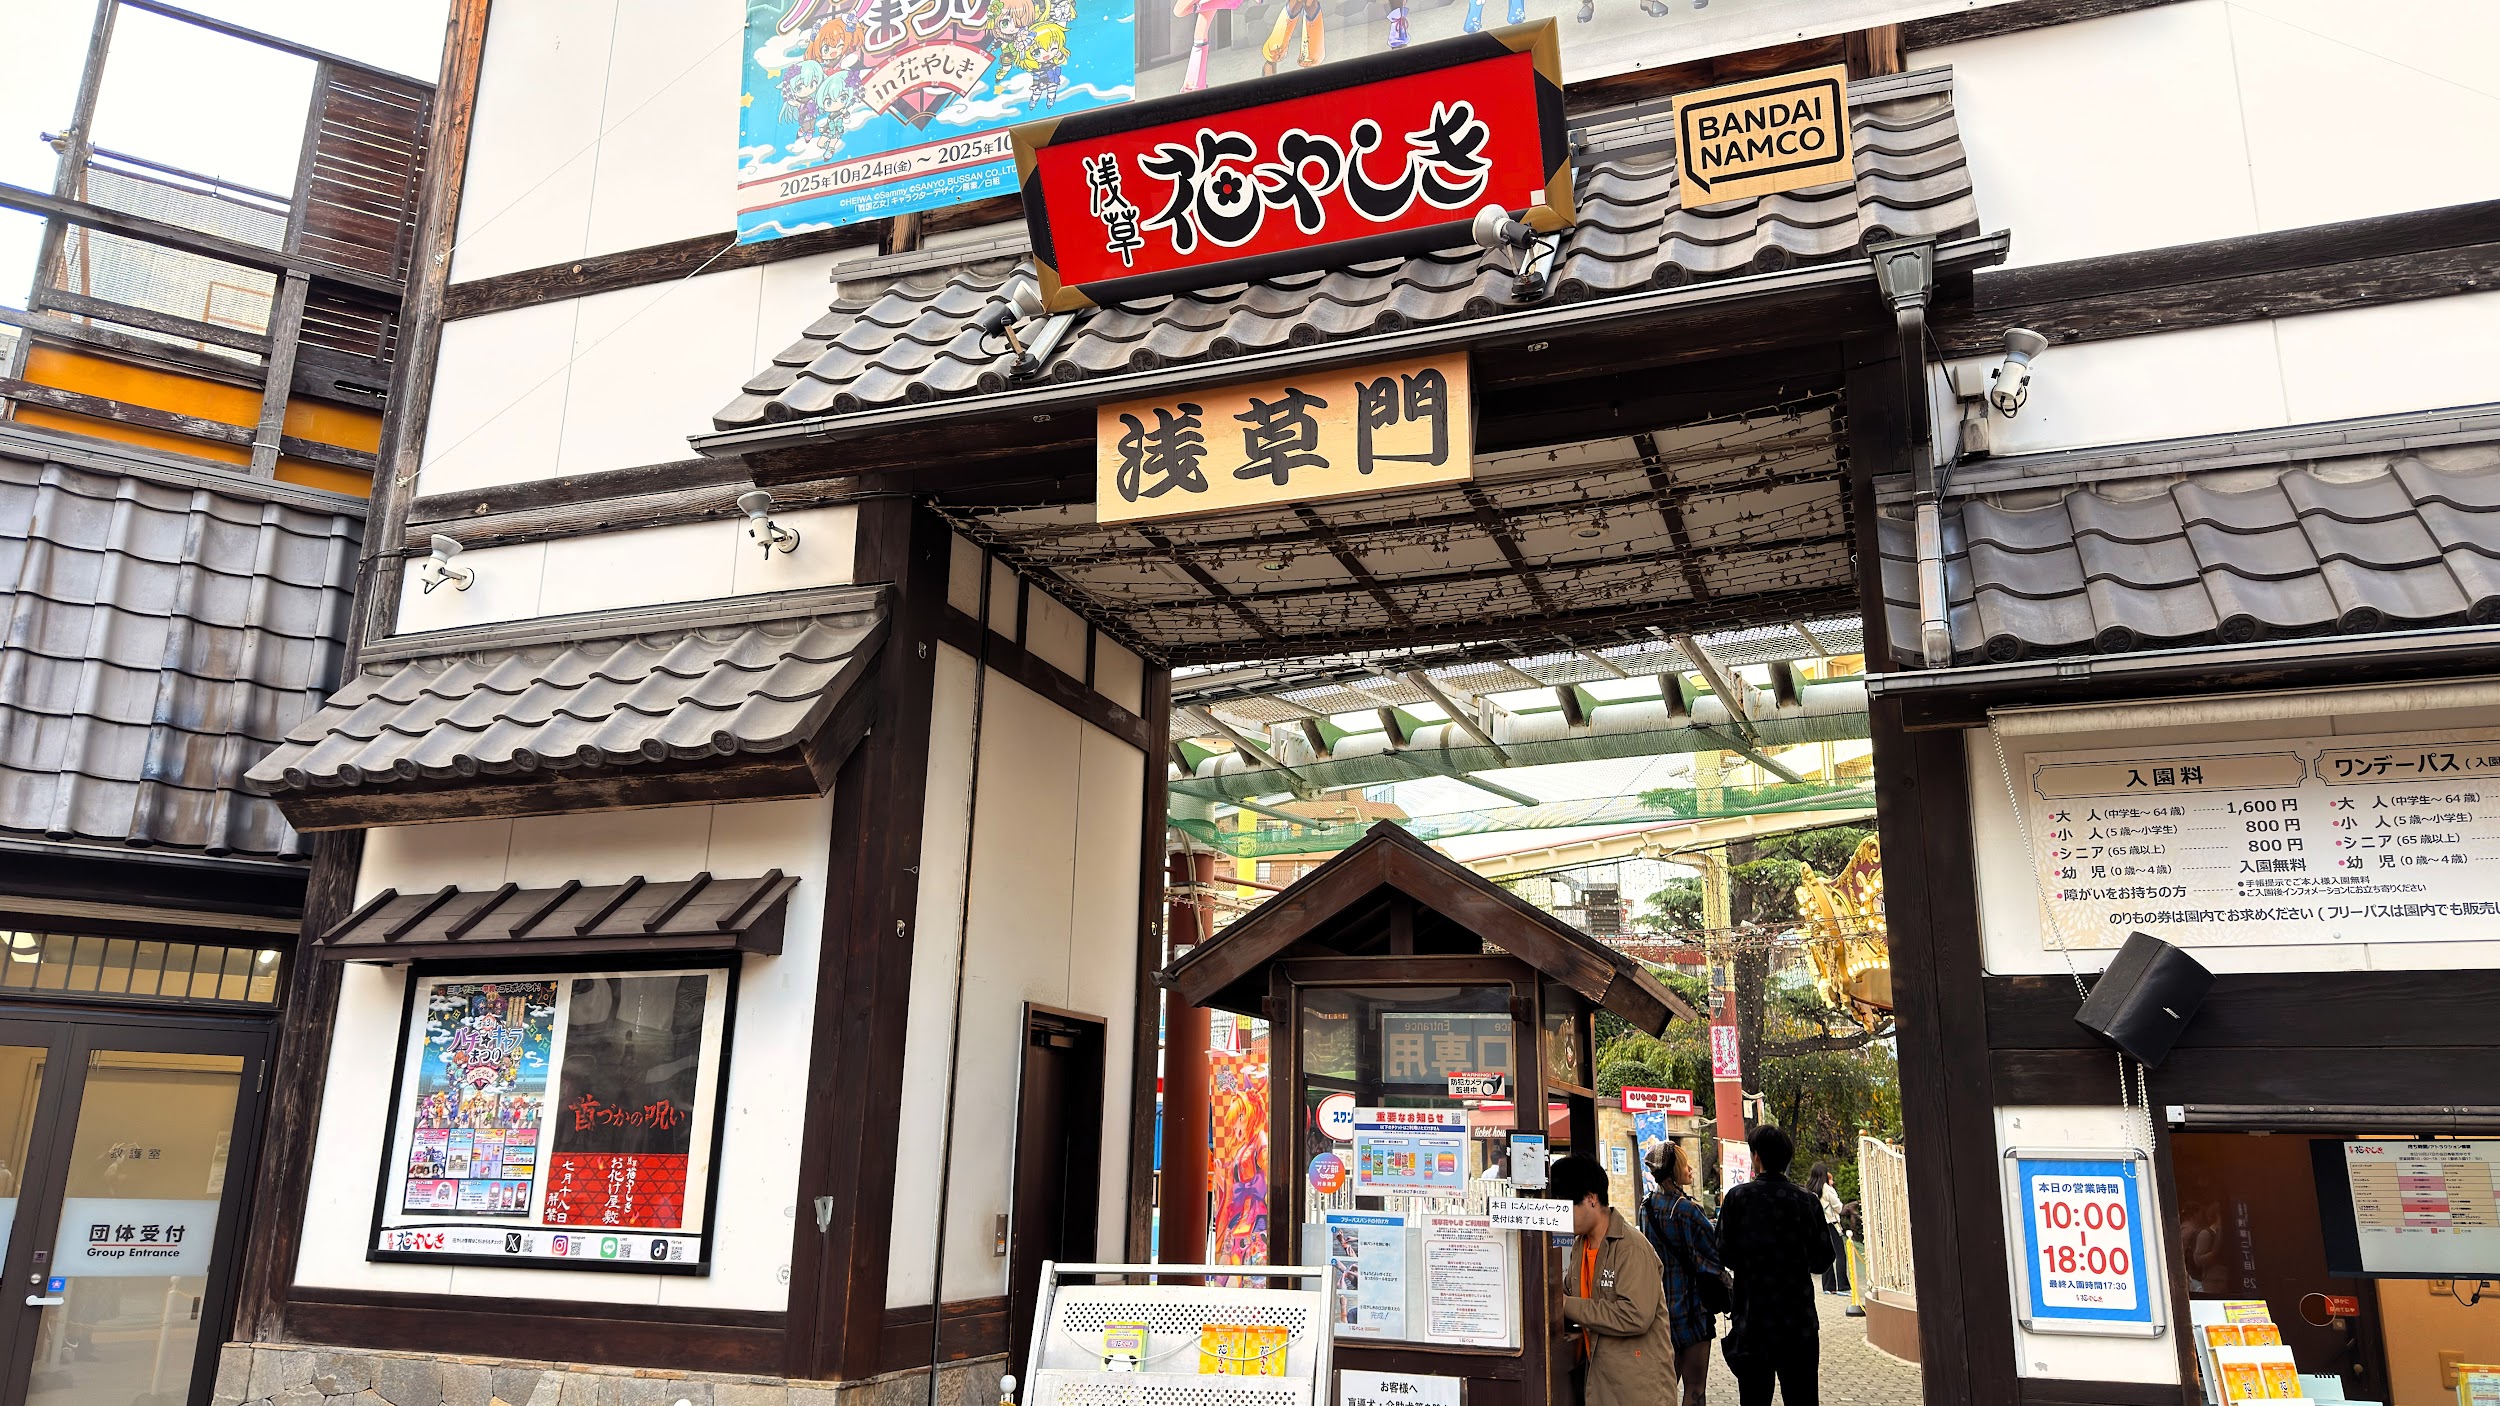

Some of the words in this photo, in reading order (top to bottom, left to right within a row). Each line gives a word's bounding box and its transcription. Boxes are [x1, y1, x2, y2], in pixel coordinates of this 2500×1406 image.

[872, 81, 897, 100] in
[893, 53, 975, 85] 花やしき
[1699, 97, 1822, 140] BANDAI
[1701, 127, 1825, 169] NAMCO
[780, 161, 912, 198] 2025年10月24日(金)
[938, 134, 1013, 164] 2025年10
[947, 172, 983, 186] BUSSAN
[1138, 99, 1493, 256] 花やしき
[1083, 152, 1148, 269] 浅草
[1117, 368, 1449, 502] 浅草門
[2335, 753, 2460, 777] ワンデーパス
[2126, 766, 2203, 787] 入園料
[2227, 798, 2298, 815] 1,600円
[2246, 818, 2301, 833] 800円
[2060, 846, 2104, 860] シニア
[2248, 838, 2304, 852] 800円
[2343, 834, 2392, 850] シニア
[2240, 858, 2307, 873] 入園無料
[2064, 885, 2187, 902] 障がいをお持ちの方
[468, 1049, 503, 1065] まつり
[1450, 1078, 1482, 1086] 防犯カメラ
[1455, 1086, 1478, 1094] 監視中
[568, 1093, 685, 1132] 首づかの呪い
[1375, 1111, 1444, 1123] 重要なお知らせ
[556, 1160, 575, 1223] 七月十八日
[602, 1157, 625, 1224] お化け屋敷
[2038, 1182, 2120, 1194] 本日の営業時間
[1492, 1200, 1507, 1210] 本日
[1492, 1214, 1559, 1226] 受付は終了しました
[2039, 1201, 2126, 1230] 10:00
[88, 1224, 186, 1243] 団体受付
[397, 1231, 445, 1250] 花やしき
[87, 1248, 125, 1259] Group
[129, 1248, 180, 1257] Entrance
[2043, 1245, 2129, 1275] 18:00
[2049, 1279, 2127, 1291] 最終入園時間17:30
[1380, 1381, 1418, 1394] お客様へ
